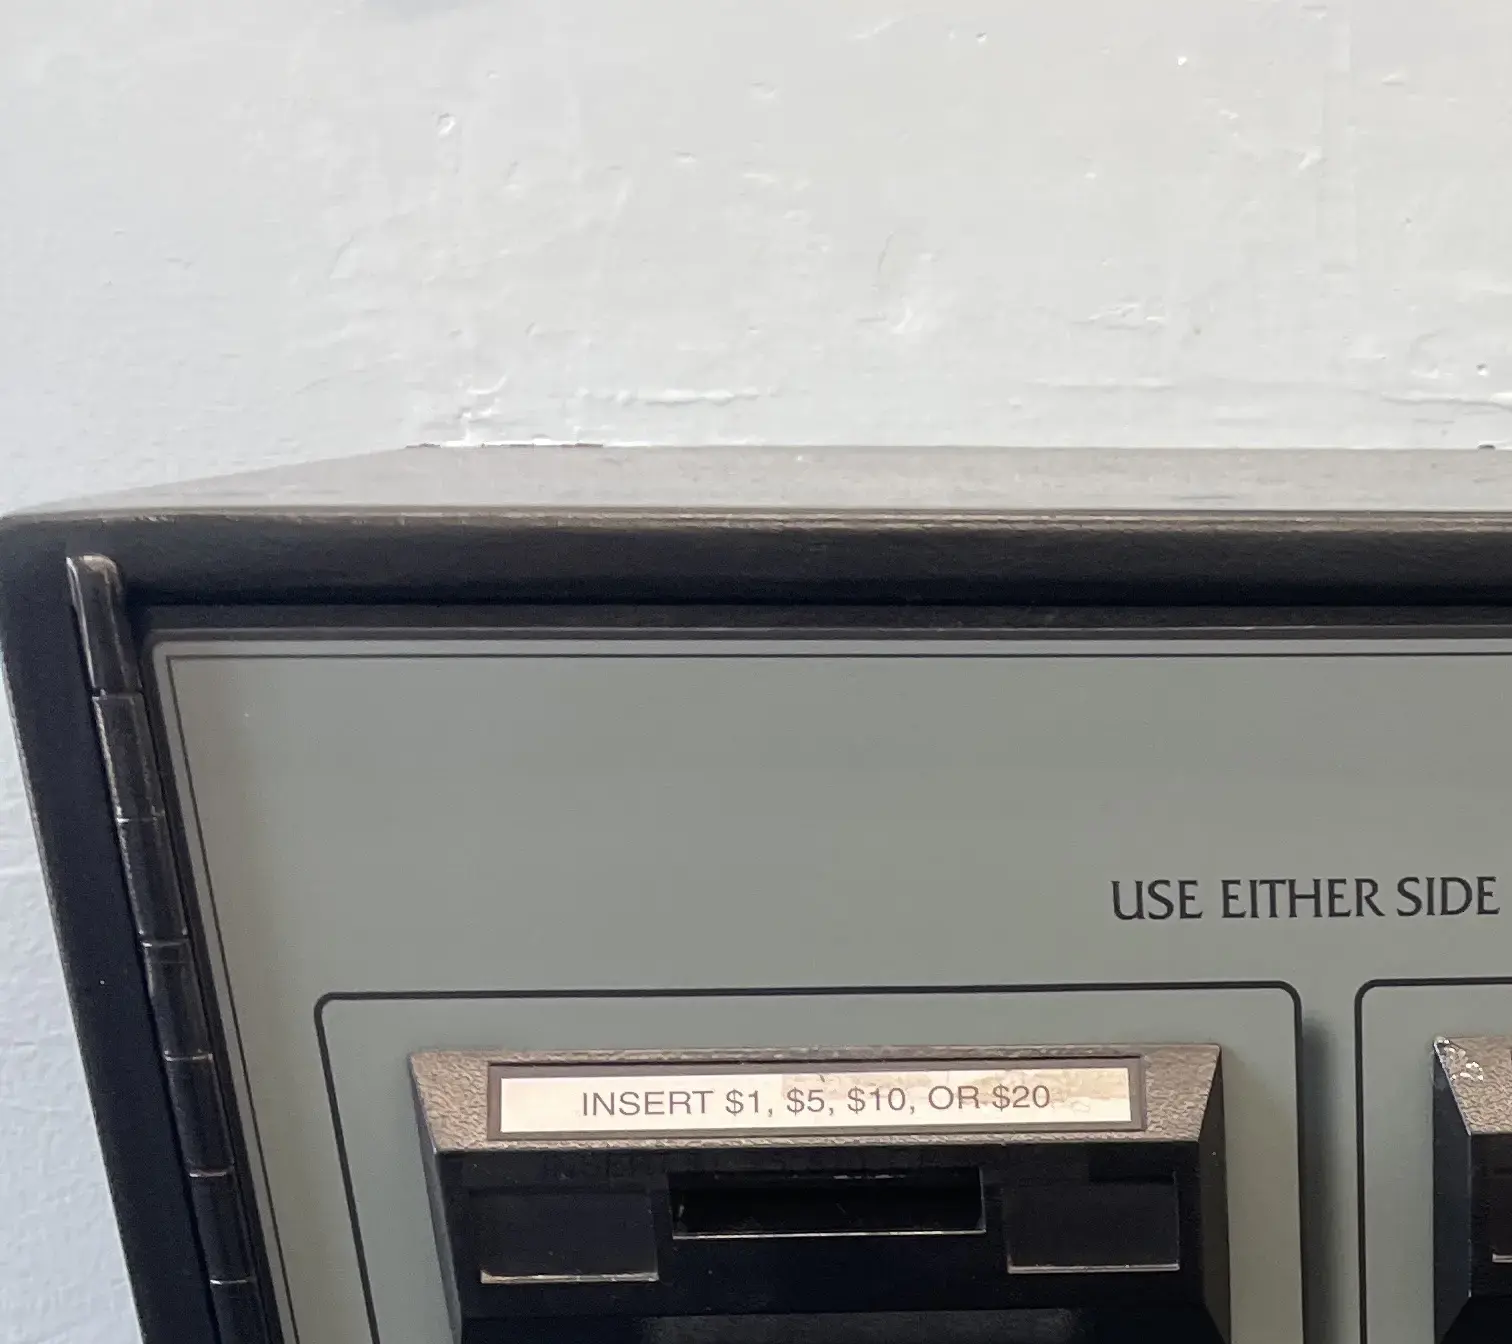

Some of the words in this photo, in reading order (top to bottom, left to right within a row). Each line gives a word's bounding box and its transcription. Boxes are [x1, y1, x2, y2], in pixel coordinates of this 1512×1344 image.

[1111, 879, 1203, 921] USE
[1221, 877, 1386, 919] EITHER
[1396, 876, 1501, 917] SIDE
[583, 1089, 715, 1117] INSERT
[725, 1088, 774, 1119] $1,
[786, 1086, 835, 1117] $5,
[847, 1085, 916, 1115] $10,
[928, 1085, 981, 1110] OR
[991, 1083, 1051, 1112] $20
